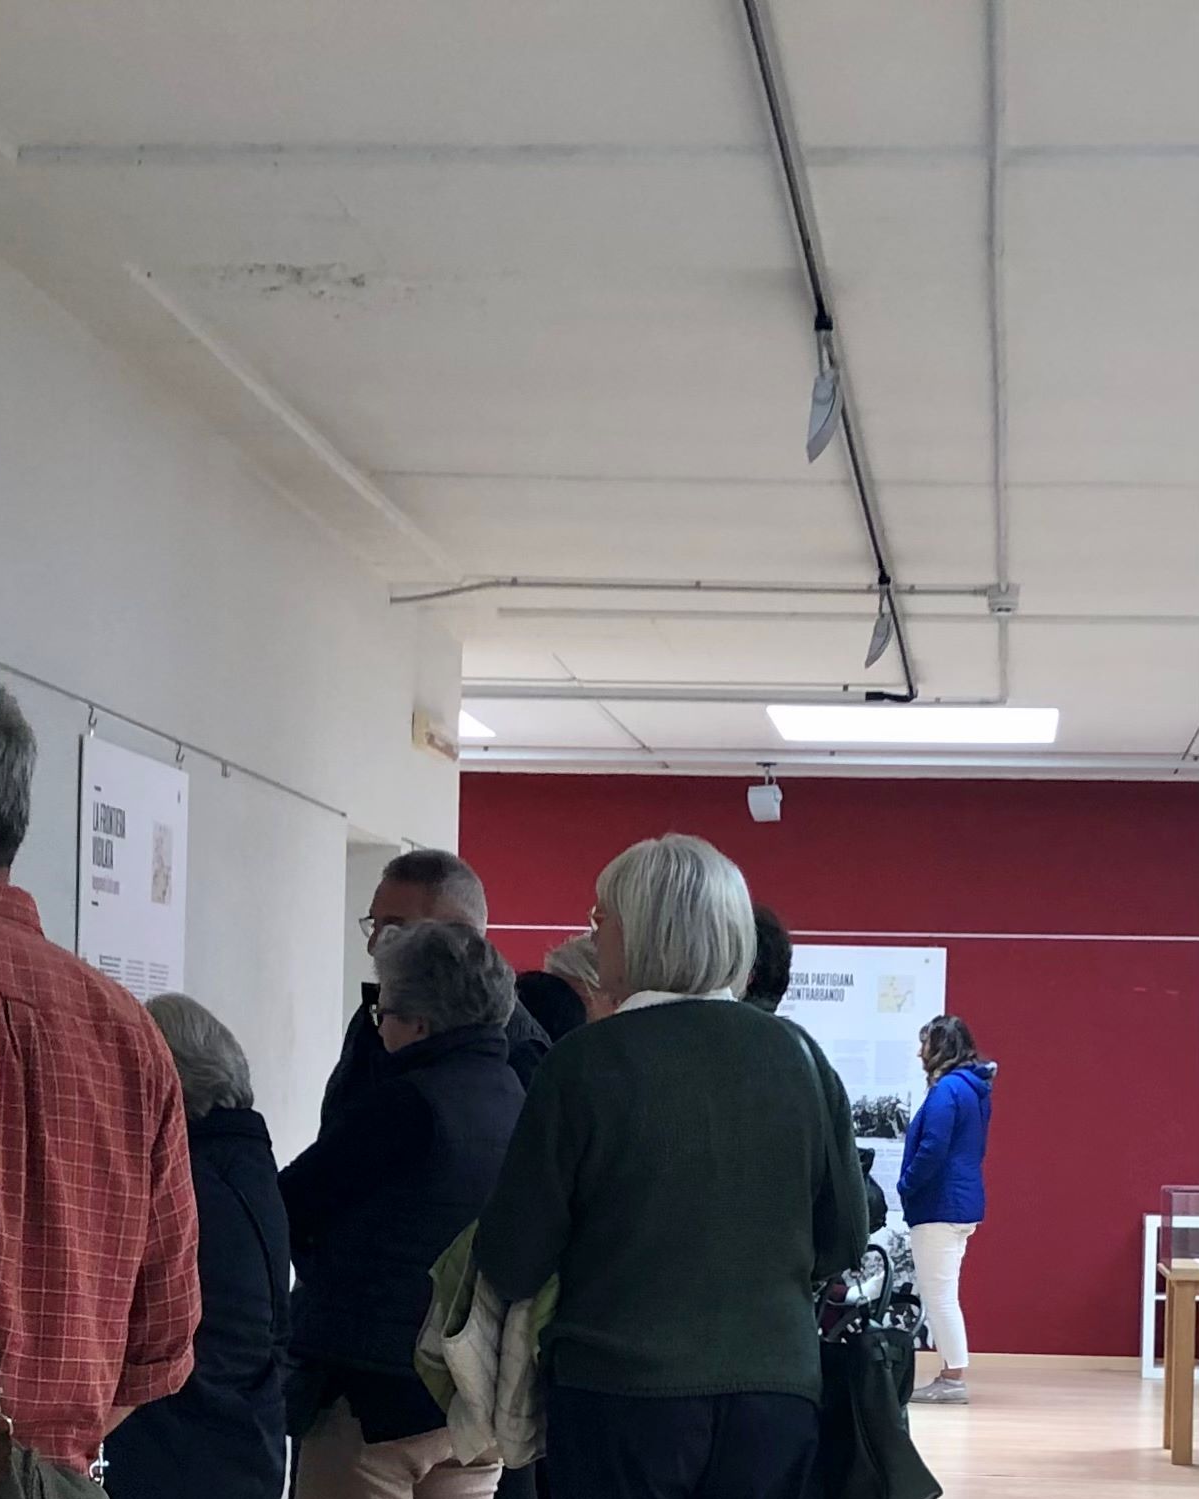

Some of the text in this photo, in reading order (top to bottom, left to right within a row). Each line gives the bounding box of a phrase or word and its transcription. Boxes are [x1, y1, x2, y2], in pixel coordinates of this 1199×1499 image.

[92, 801, 126, 839] LA FRONTIERA
[92, 836, 114, 869] VIGILATA
[789, 971, 854, 987] ERRA PARTIGIANA
[786, 987, 845, 1002] CONTRABBANDO
